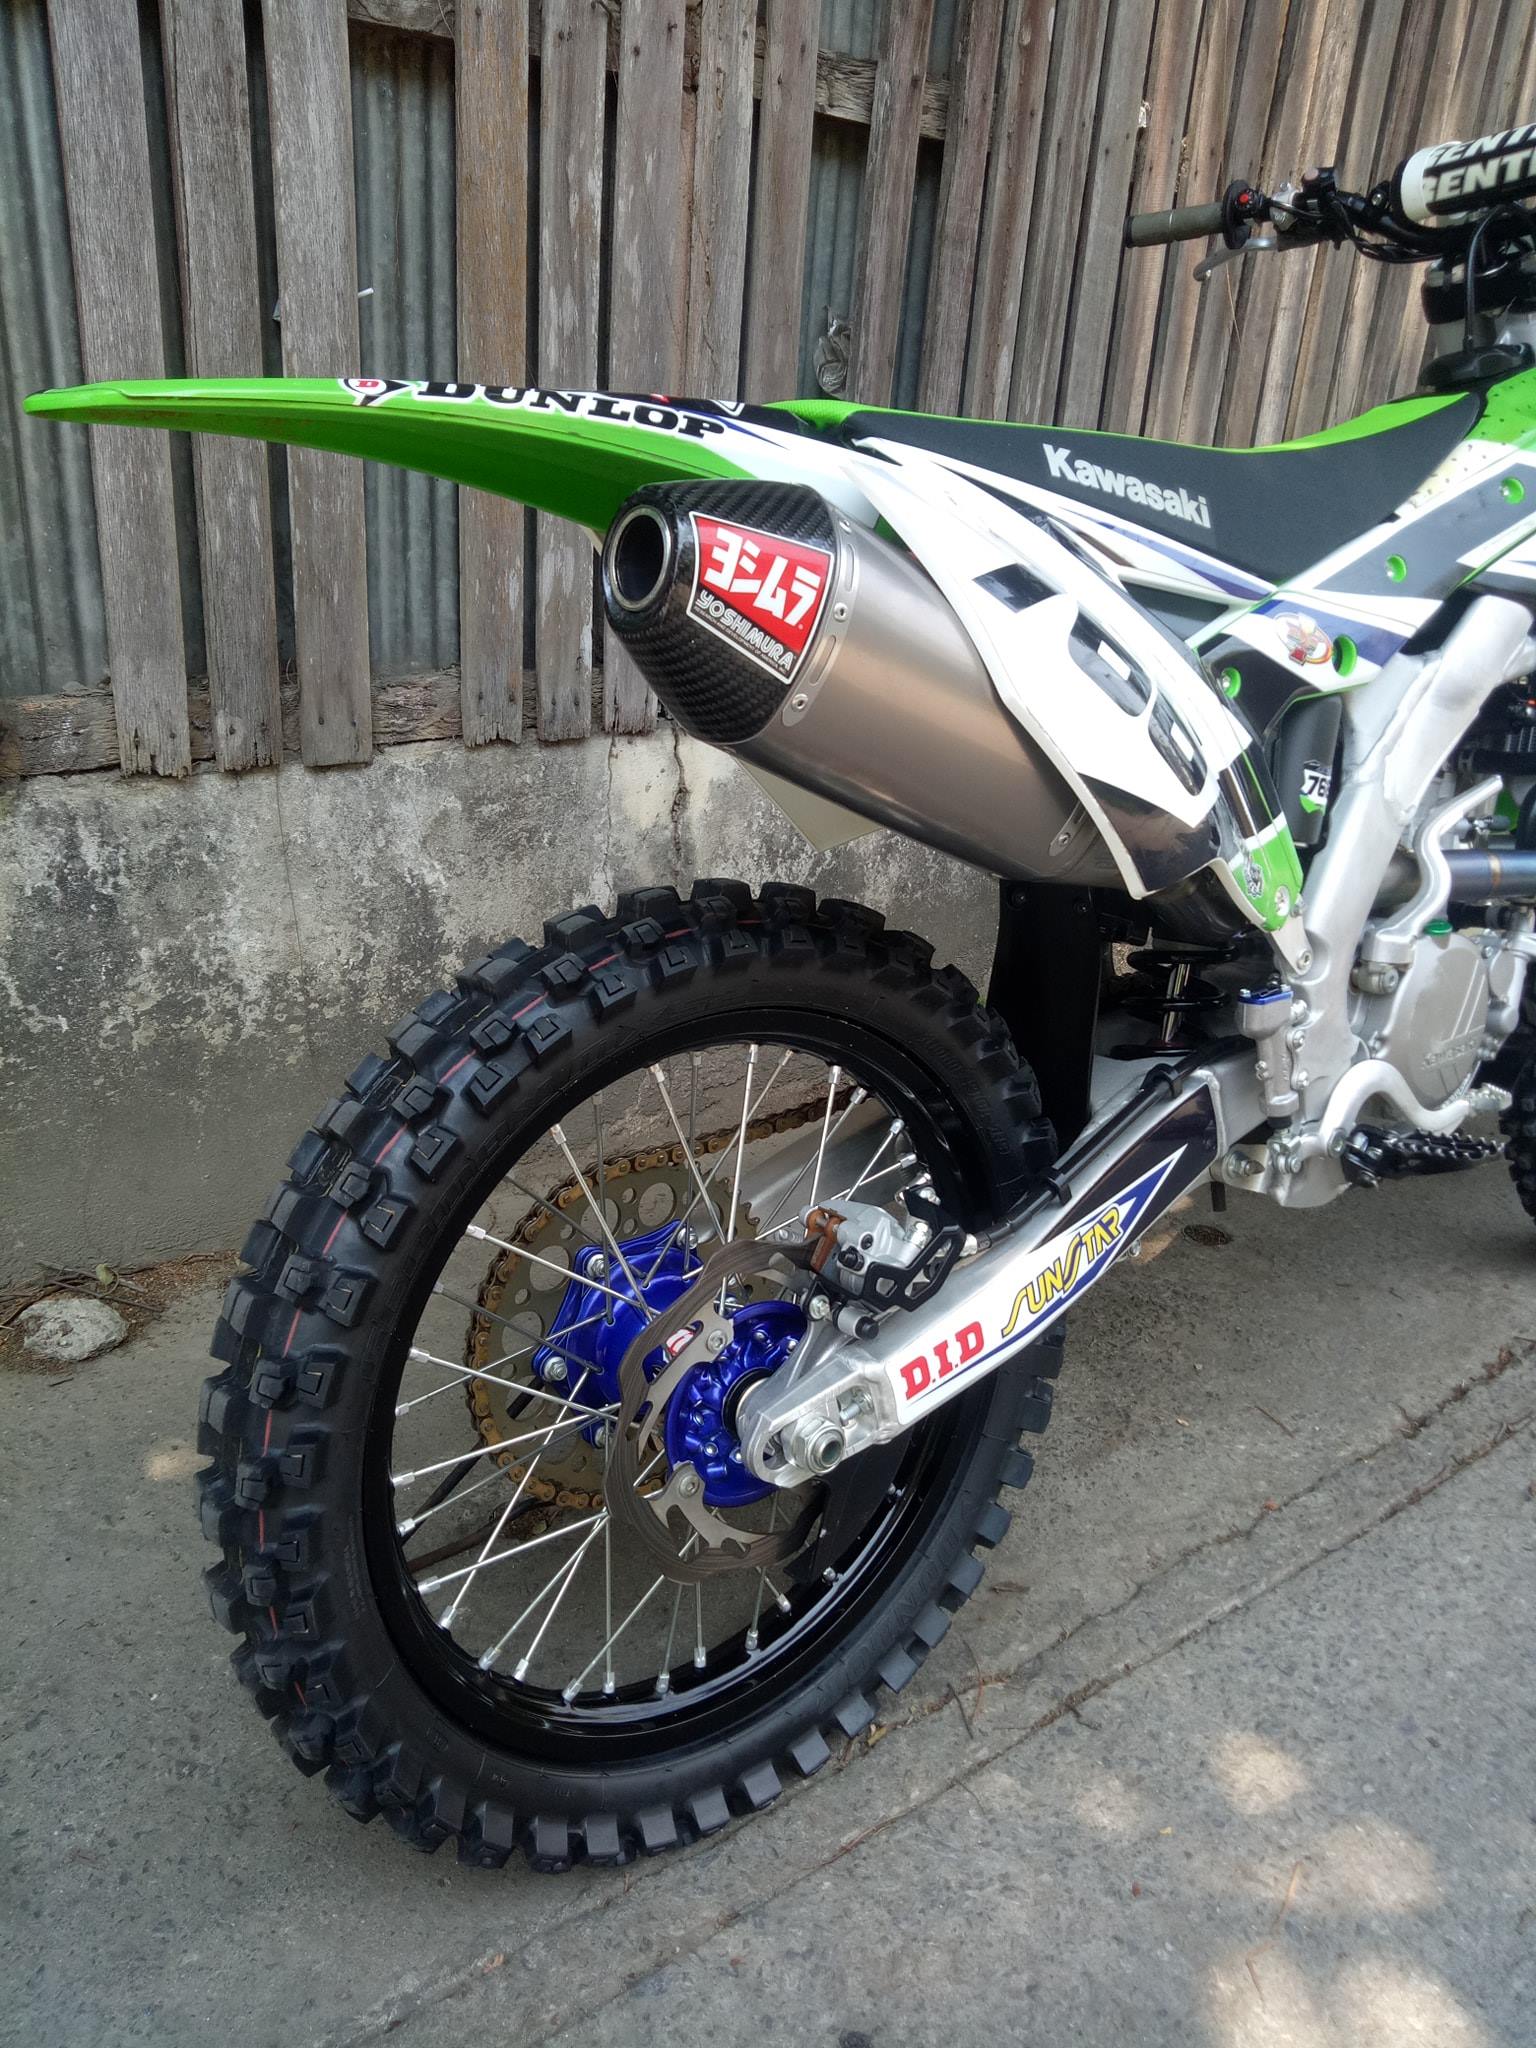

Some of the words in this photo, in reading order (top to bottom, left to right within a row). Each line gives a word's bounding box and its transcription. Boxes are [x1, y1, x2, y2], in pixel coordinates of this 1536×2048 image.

[417, 381, 725, 438] DUNLOP
[1043, 443, 1211, 528] Kawasaki
[704, 527, 821, 626] ヨシムラ
[696, 590, 795, 671] YOSHIMURA
[1001, 1207, 1121, 1338] SUNSTAR
[900, 1321, 985, 1400] D.I.D
